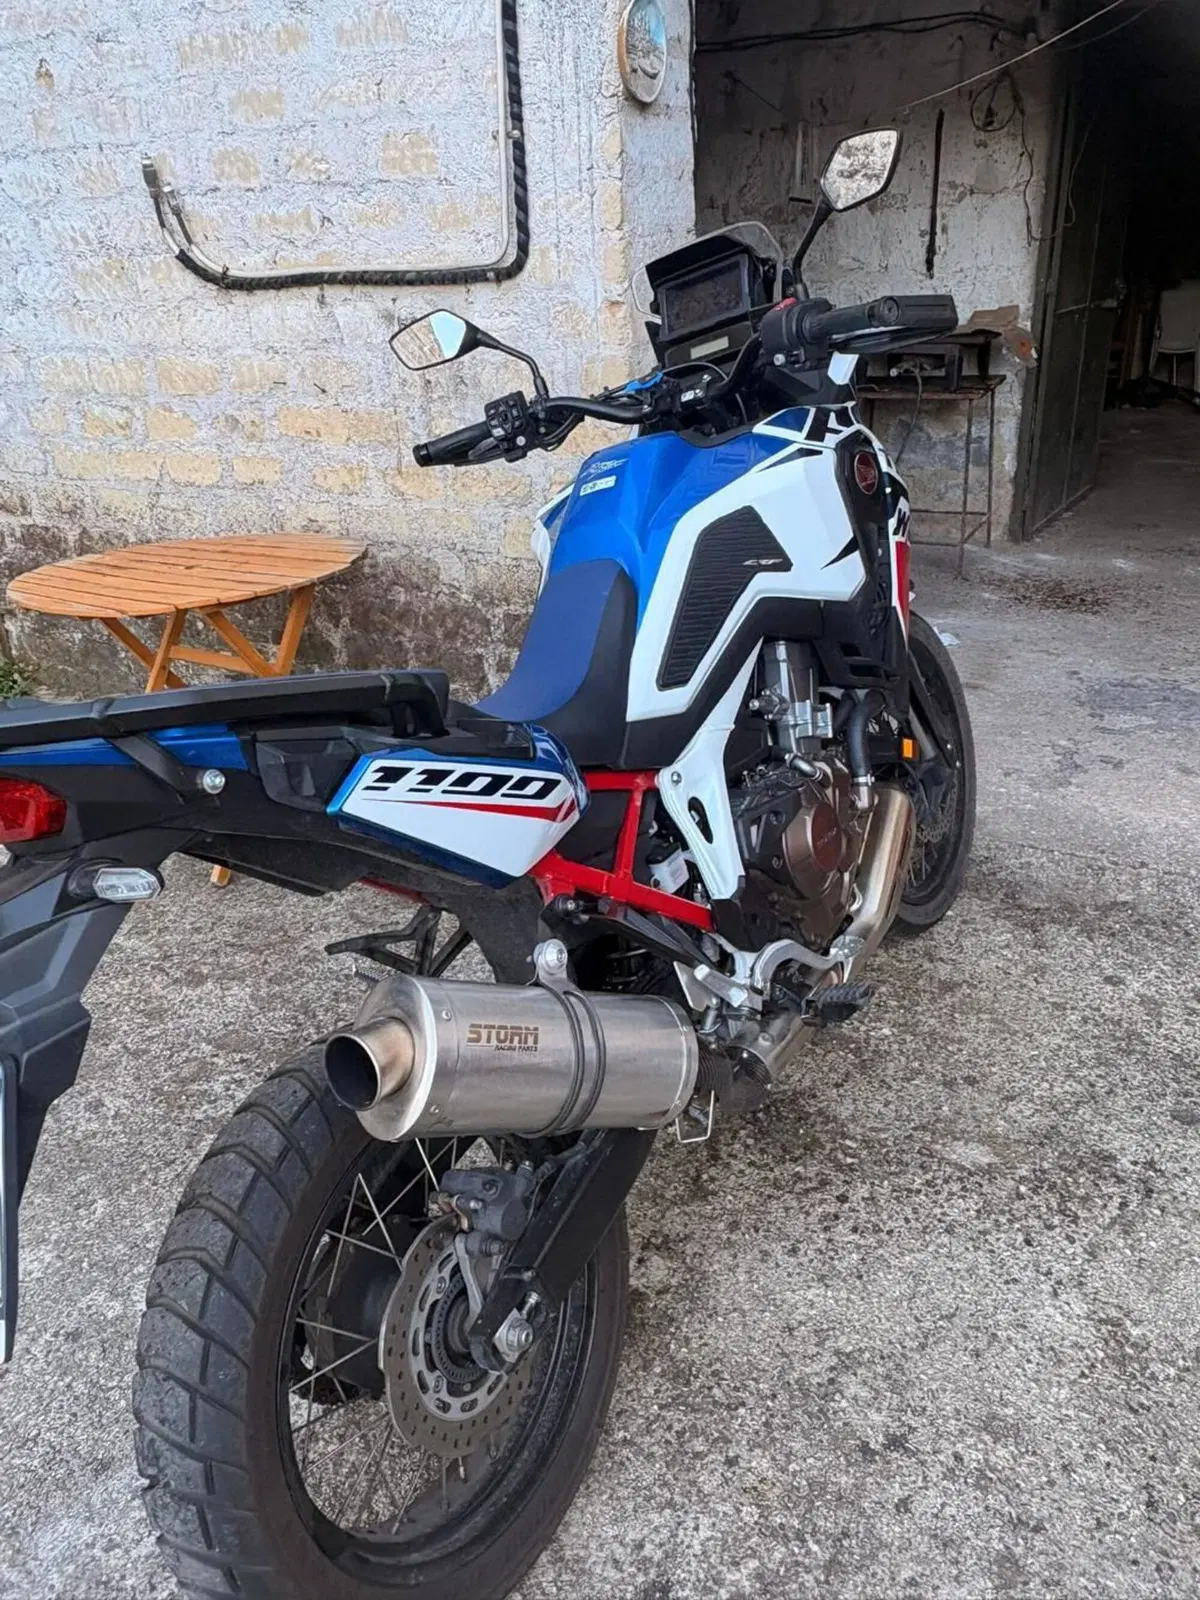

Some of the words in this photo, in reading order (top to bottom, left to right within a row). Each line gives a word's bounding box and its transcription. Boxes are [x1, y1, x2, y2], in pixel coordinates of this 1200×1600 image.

[361, 765, 562, 800] 1100
[466, 1023, 539, 1044] STORM
[518, 1045, 538, 1053] PARTS
